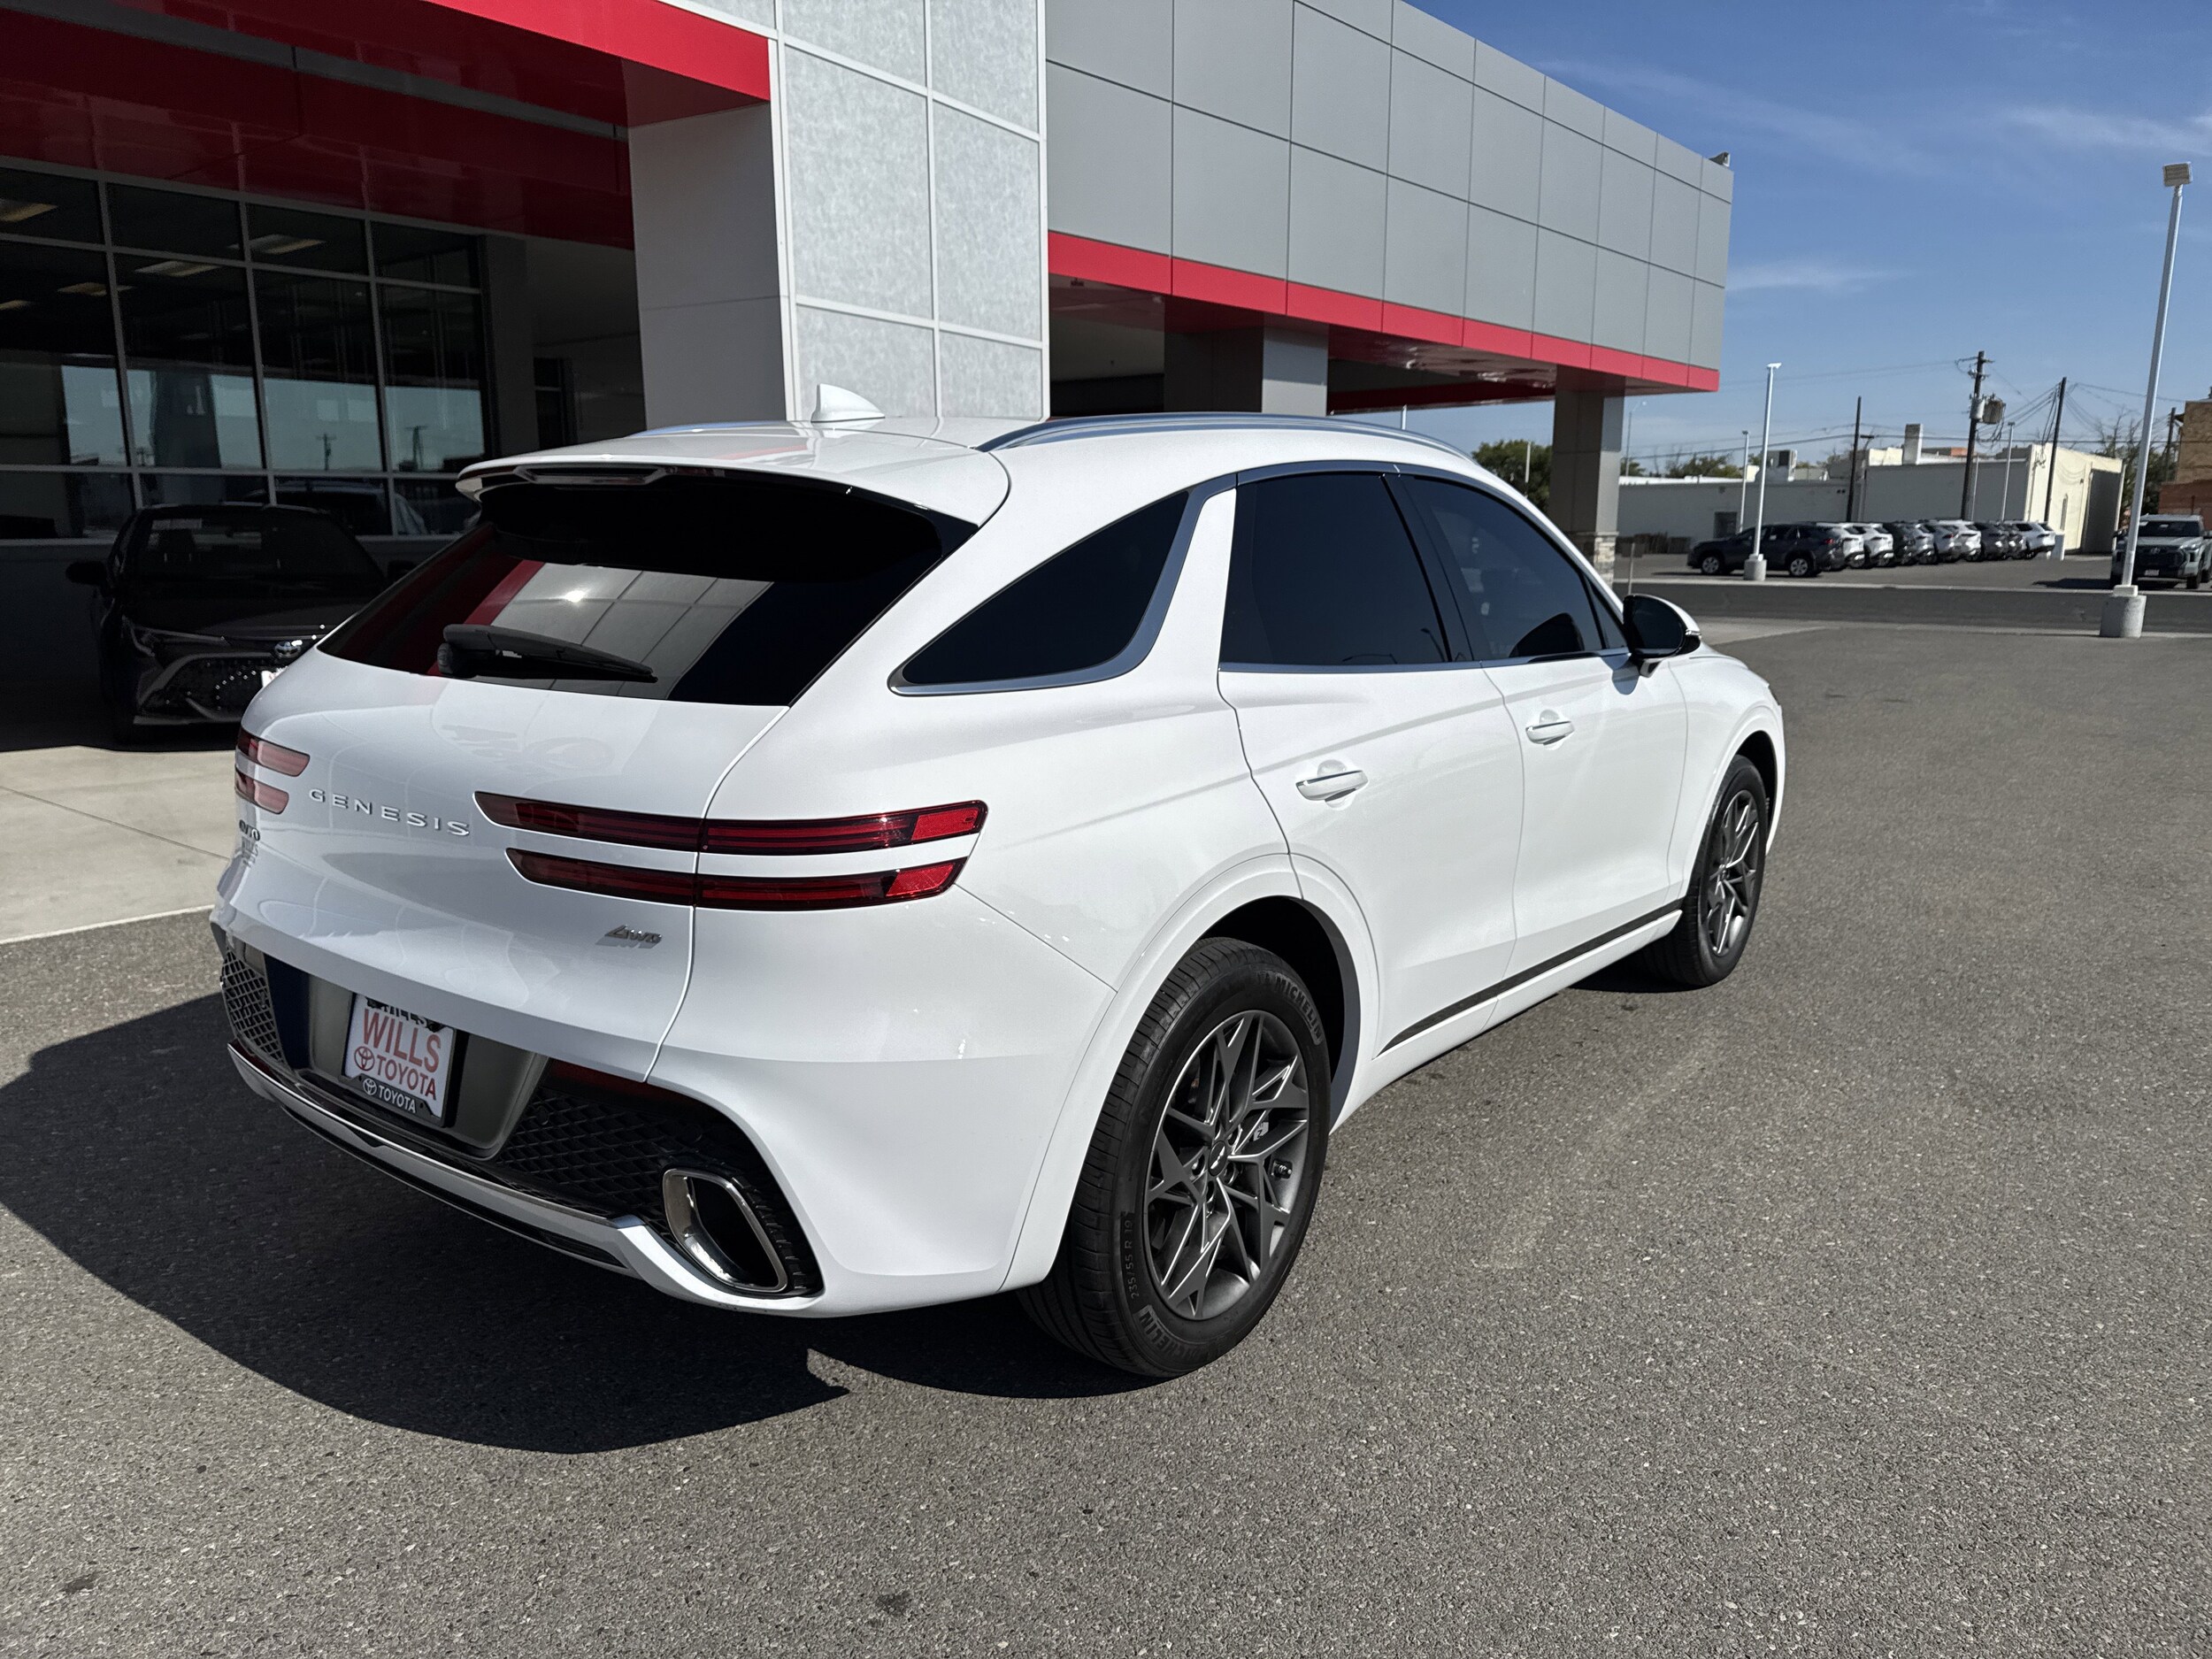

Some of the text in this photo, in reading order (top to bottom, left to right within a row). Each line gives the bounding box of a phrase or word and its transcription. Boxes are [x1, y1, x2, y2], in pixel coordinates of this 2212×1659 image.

[309, 788, 471, 838] GENESIS
[1275, 975, 1323, 1039] MICHELIN
[363, 1008, 442, 1073] WILLS
[376, 1054, 437, 1101] TOYOTA
[379, 1085, 417, 1114] TOYOTA
[1125, 1251, 1140, 1300] 235/55
